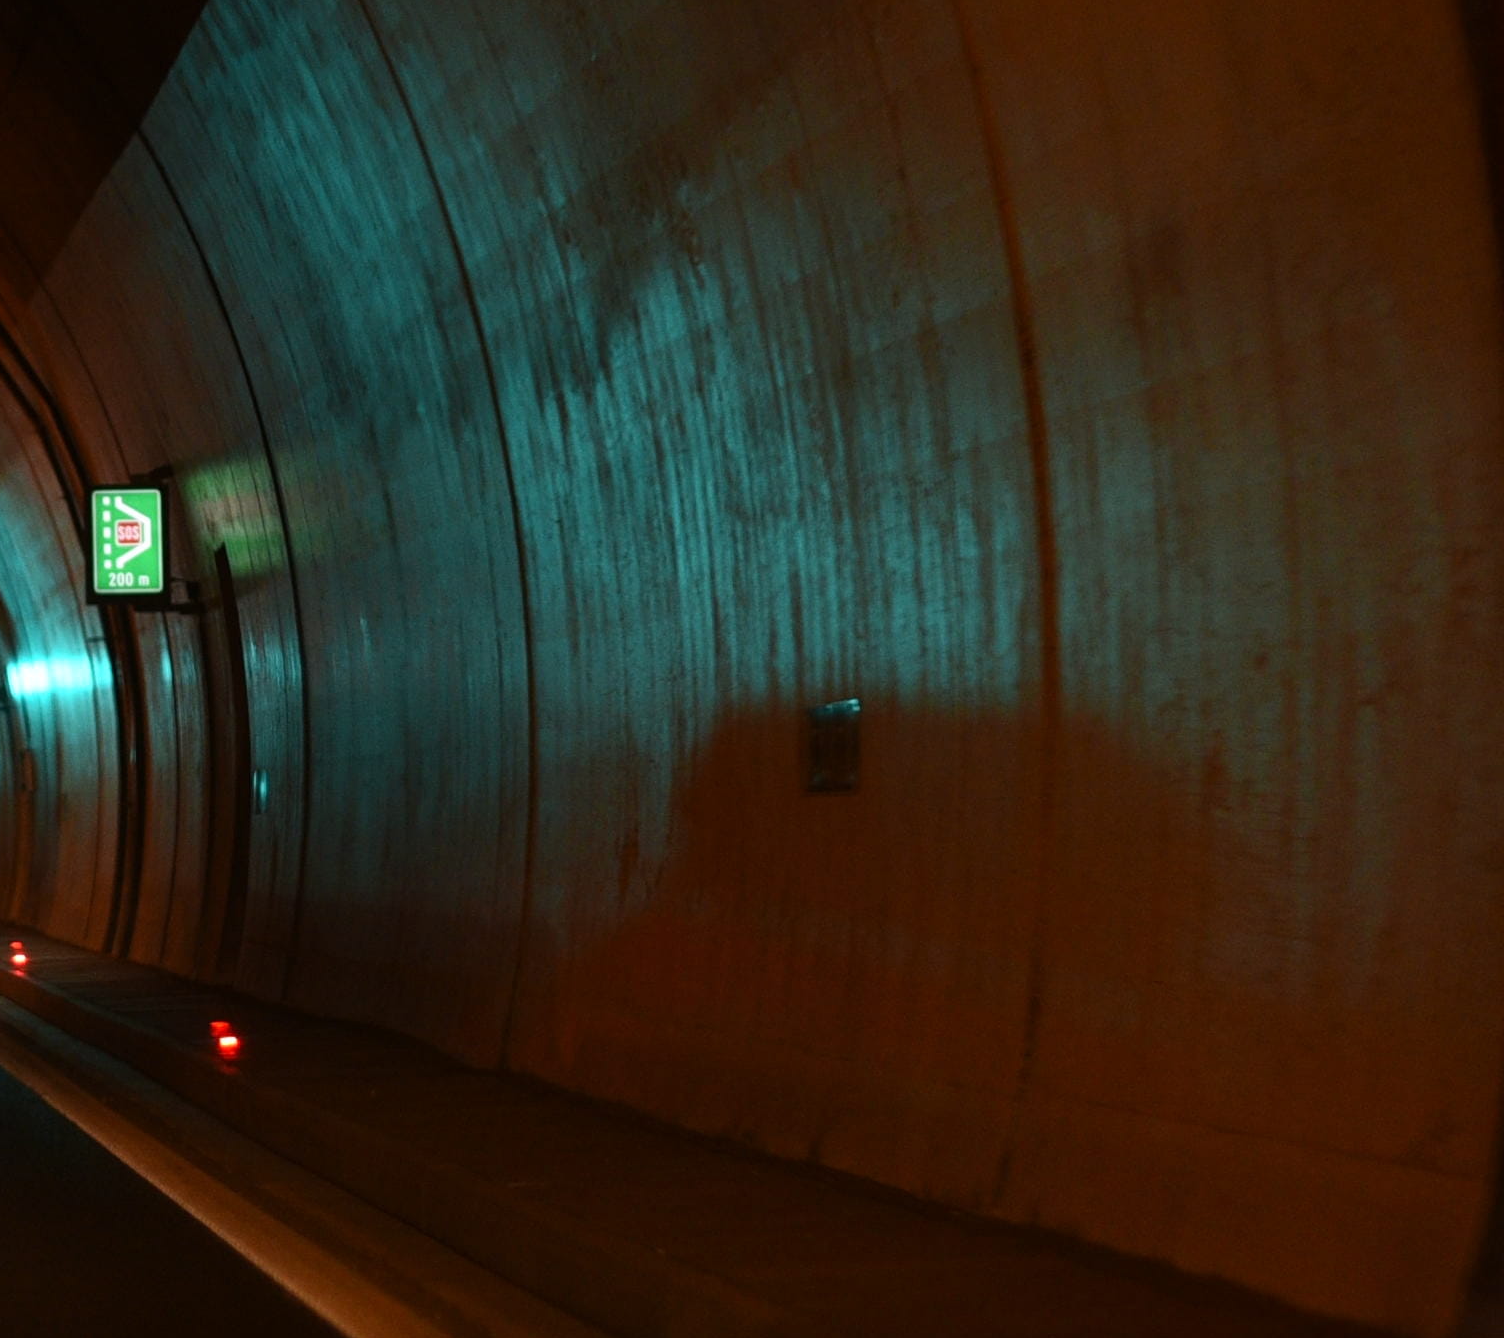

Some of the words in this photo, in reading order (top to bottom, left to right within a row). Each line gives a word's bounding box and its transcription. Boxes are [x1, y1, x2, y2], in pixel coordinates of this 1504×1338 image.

[118, 525, 140, 541] SOS
[108, 572, 134, 587] 200
[138, 575, 150, 587] m
